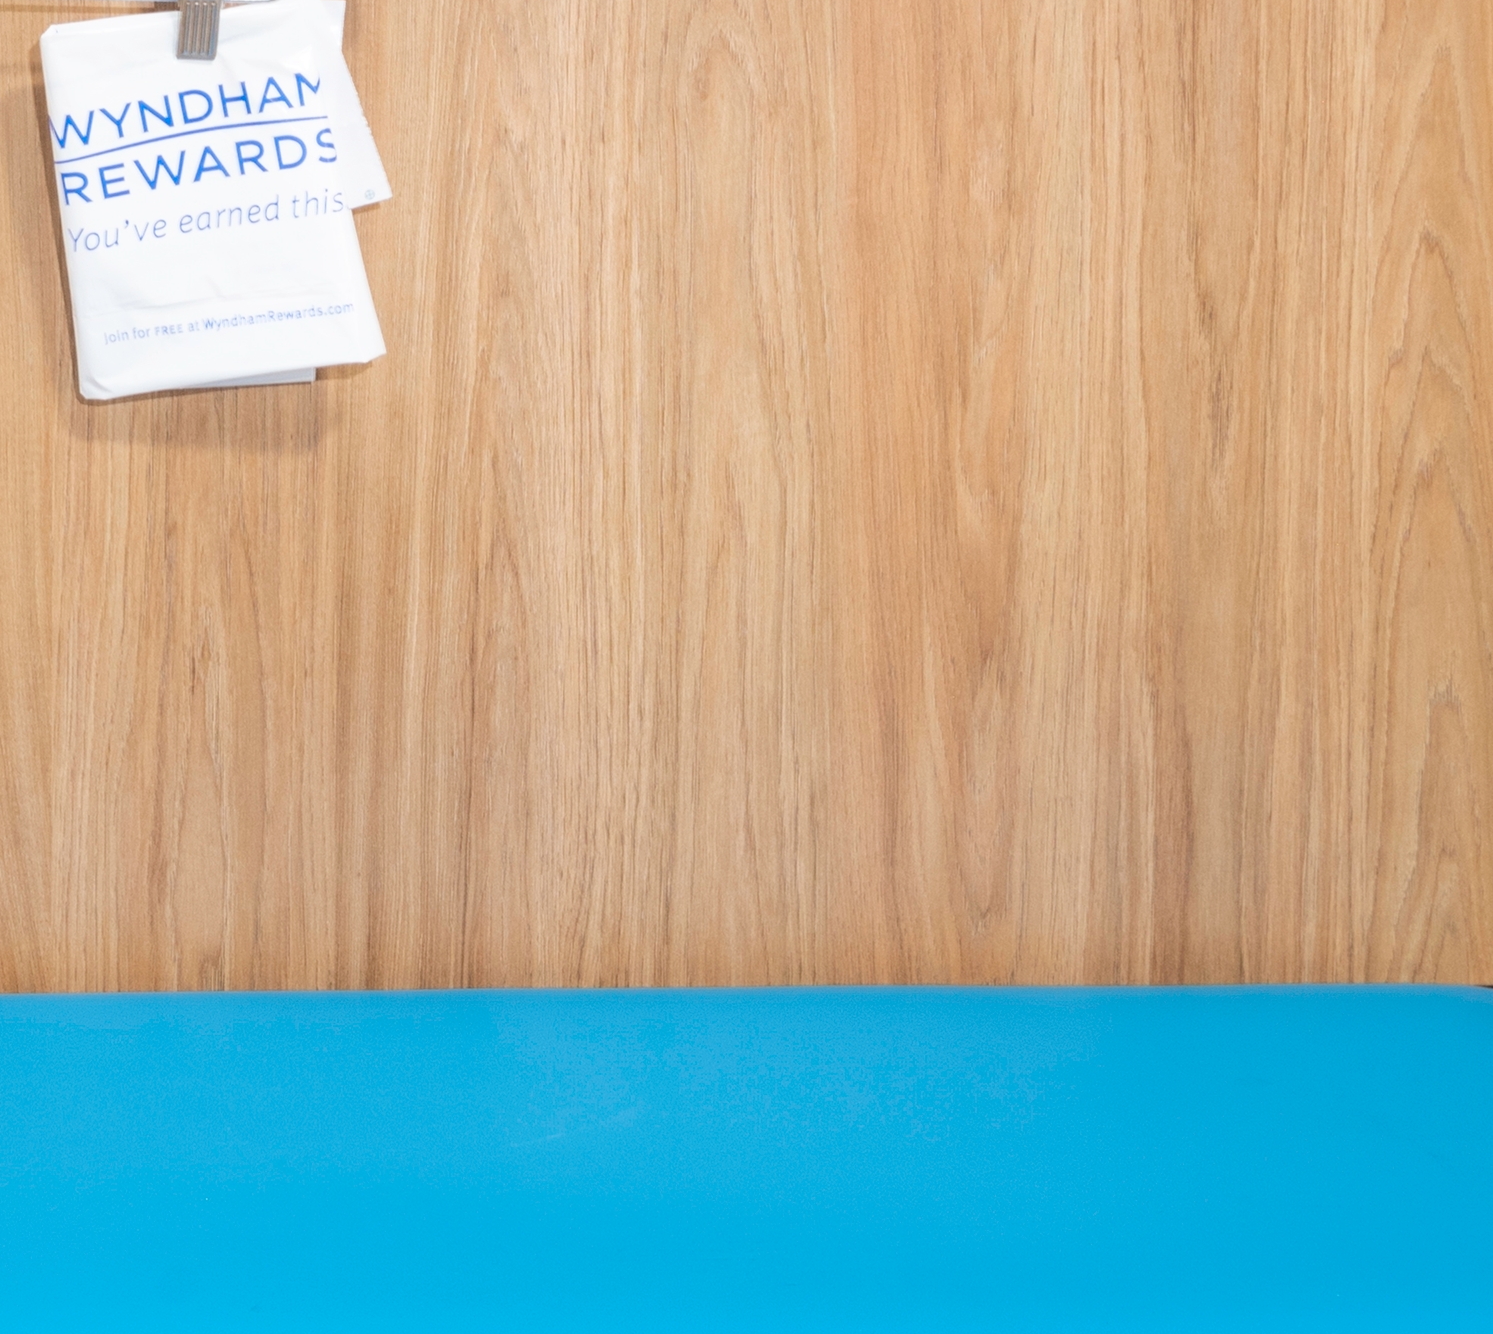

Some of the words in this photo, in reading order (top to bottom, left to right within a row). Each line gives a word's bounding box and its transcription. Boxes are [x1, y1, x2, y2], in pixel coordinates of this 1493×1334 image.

[60, 128, 337, 206] REWARDS
[68, 218, 167, 253] You've
[179, 194, 279, 234] earned
[132, 325, 150, 340] for
[155, 323, 183, 336] FREE
[188, 320, 201, 332] at
[203, 302, 354, 332] WyndhamRewards.com
